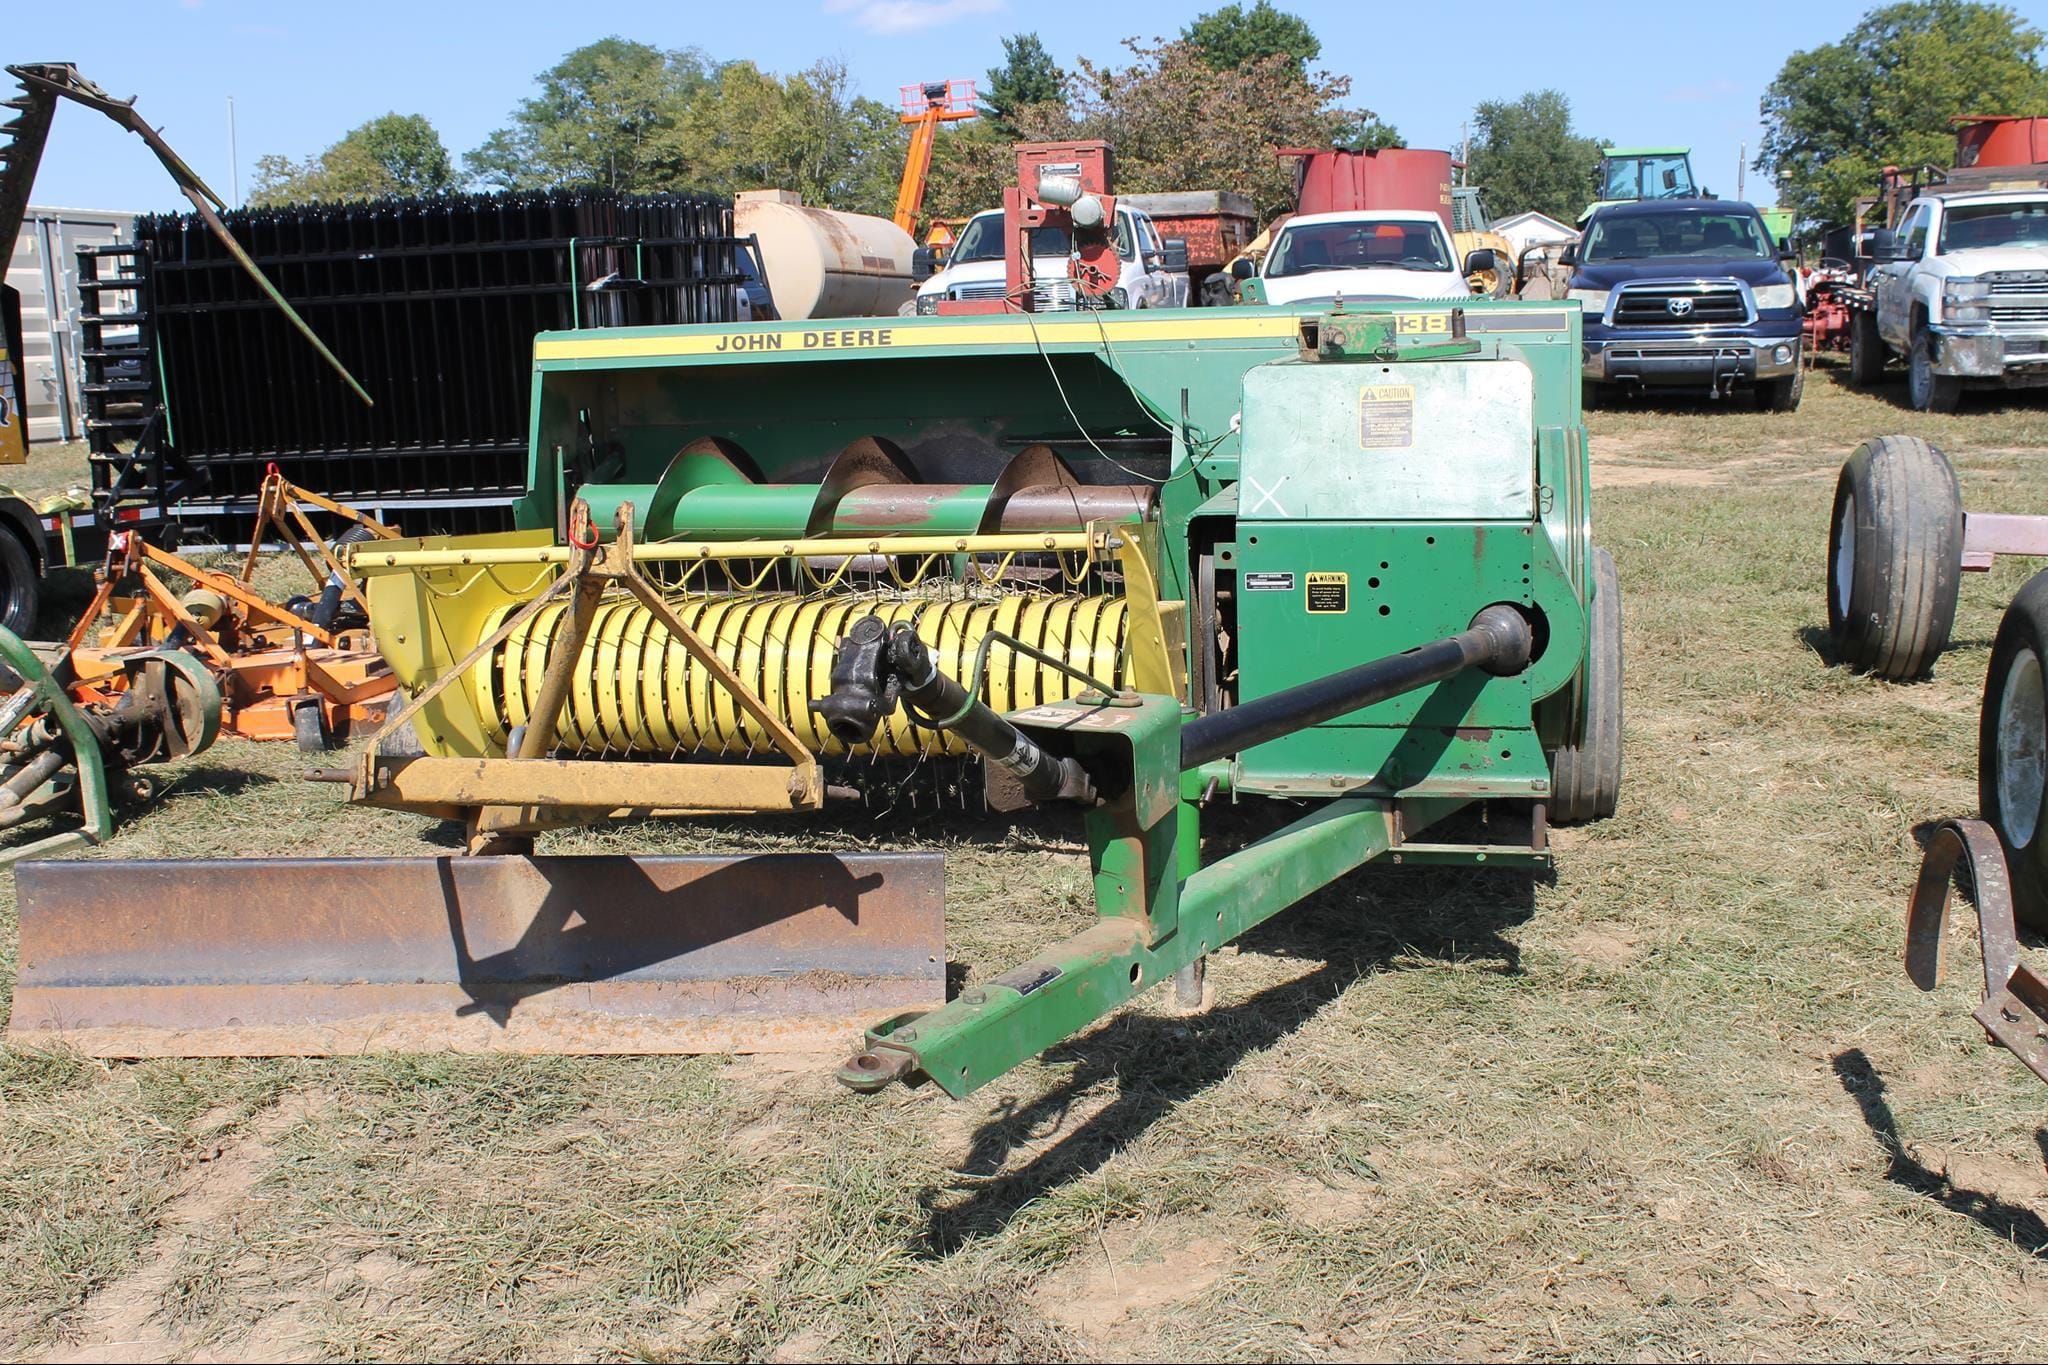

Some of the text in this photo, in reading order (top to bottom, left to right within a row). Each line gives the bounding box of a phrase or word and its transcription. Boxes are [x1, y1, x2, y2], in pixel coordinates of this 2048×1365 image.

[1395, 315, 1447, 333] 38
[716, 329, 892, 351] JOHN DEERE
[1379, 387, 1410, 399] CAUTION
[1319, 574, 1346, 583] WARNING
